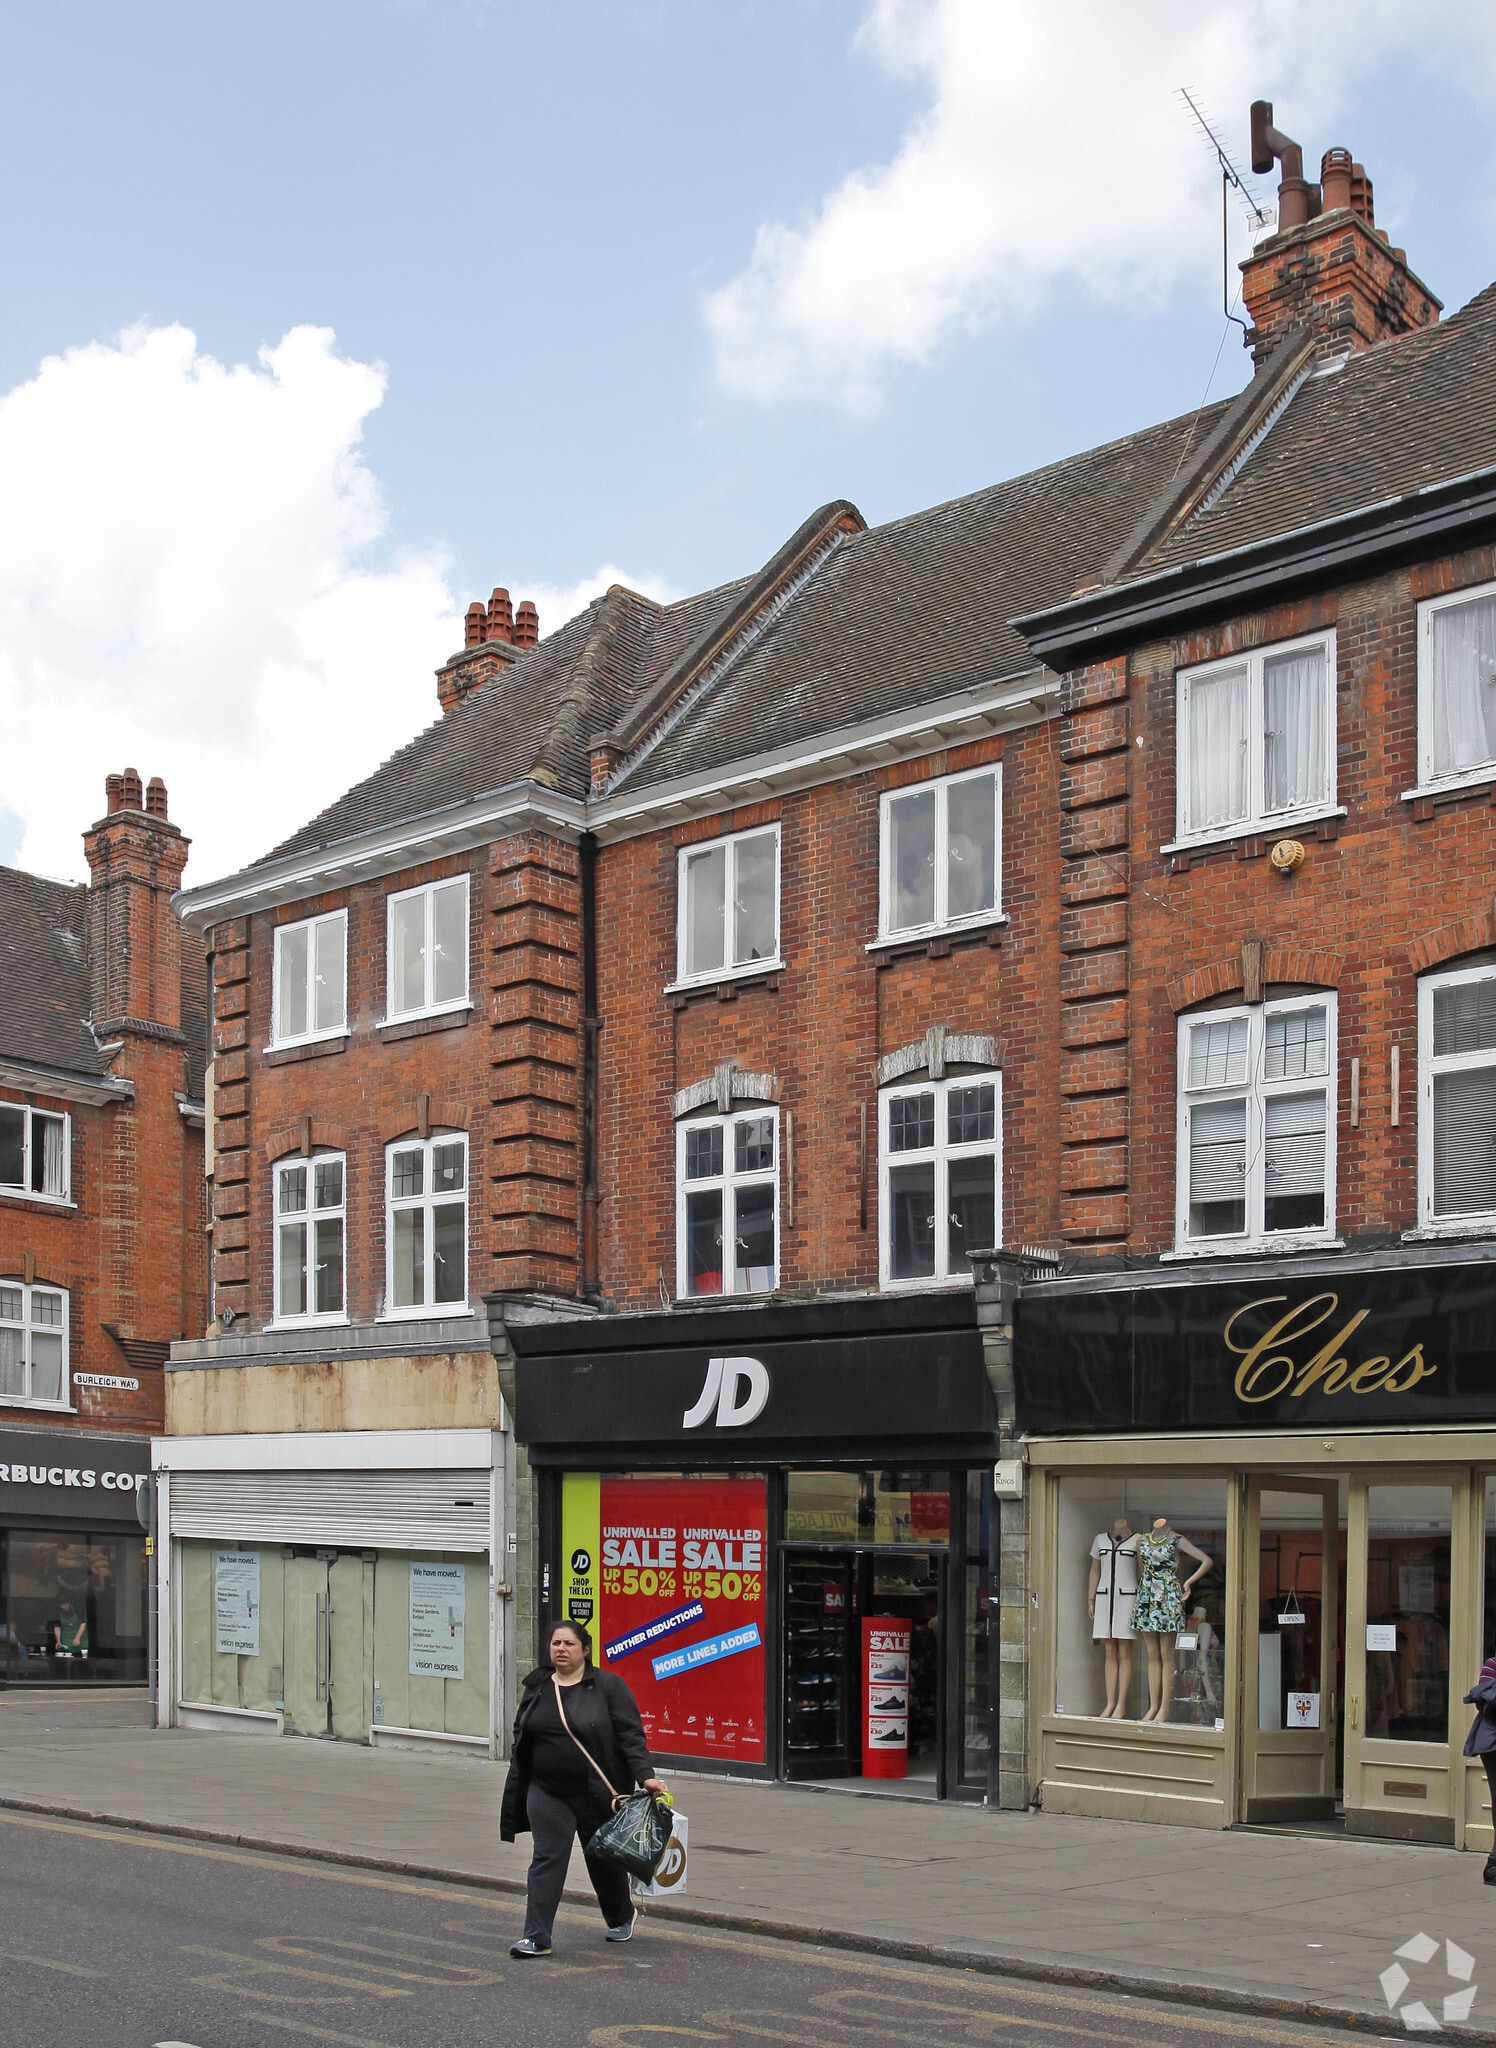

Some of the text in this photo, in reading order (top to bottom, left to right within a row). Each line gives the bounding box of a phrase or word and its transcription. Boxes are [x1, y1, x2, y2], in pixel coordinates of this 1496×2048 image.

[1224, 1292, 1437, 1402] Ches
[77, 1375, 117, 1387] BURLEIGH
[683, 1357, 769, 1428] JD
[603, 1526, 676, 1539] UNRIVALLED
[683, 1528, 762, 1541] UNRIVALLED
[602, 1539, 676, 1568] SALE
[682, 1541, 762, 1571] SALE
[574, 1554, 588, 1568] JD
[423, 1569, 436, 1577] have
[603, 1568, 620, 1580] UP
[683, 1572, 702, 1584] UP
[572, 1578, 589, 1586] SHOP
[603, 1582, 621, 1594] TO
[622, 1569, 676, 1596] 50%
[704, 1572, 761, 1600] 50%
[569, 1586, 580, 1595] THE
[659, 1589, 674, 1597] OFF
[683, 1586, 702, 1598] TO
[606, 1604, 703, 1658] FURTHER REDUCTIONS
[870, 1637, 910, 1650] SALE
[654, 1630, 757, 1674] MORE LINES ADDED
[415, 1660, 458, 1672] vision express
[656, 1848, 682, 1876] JD
